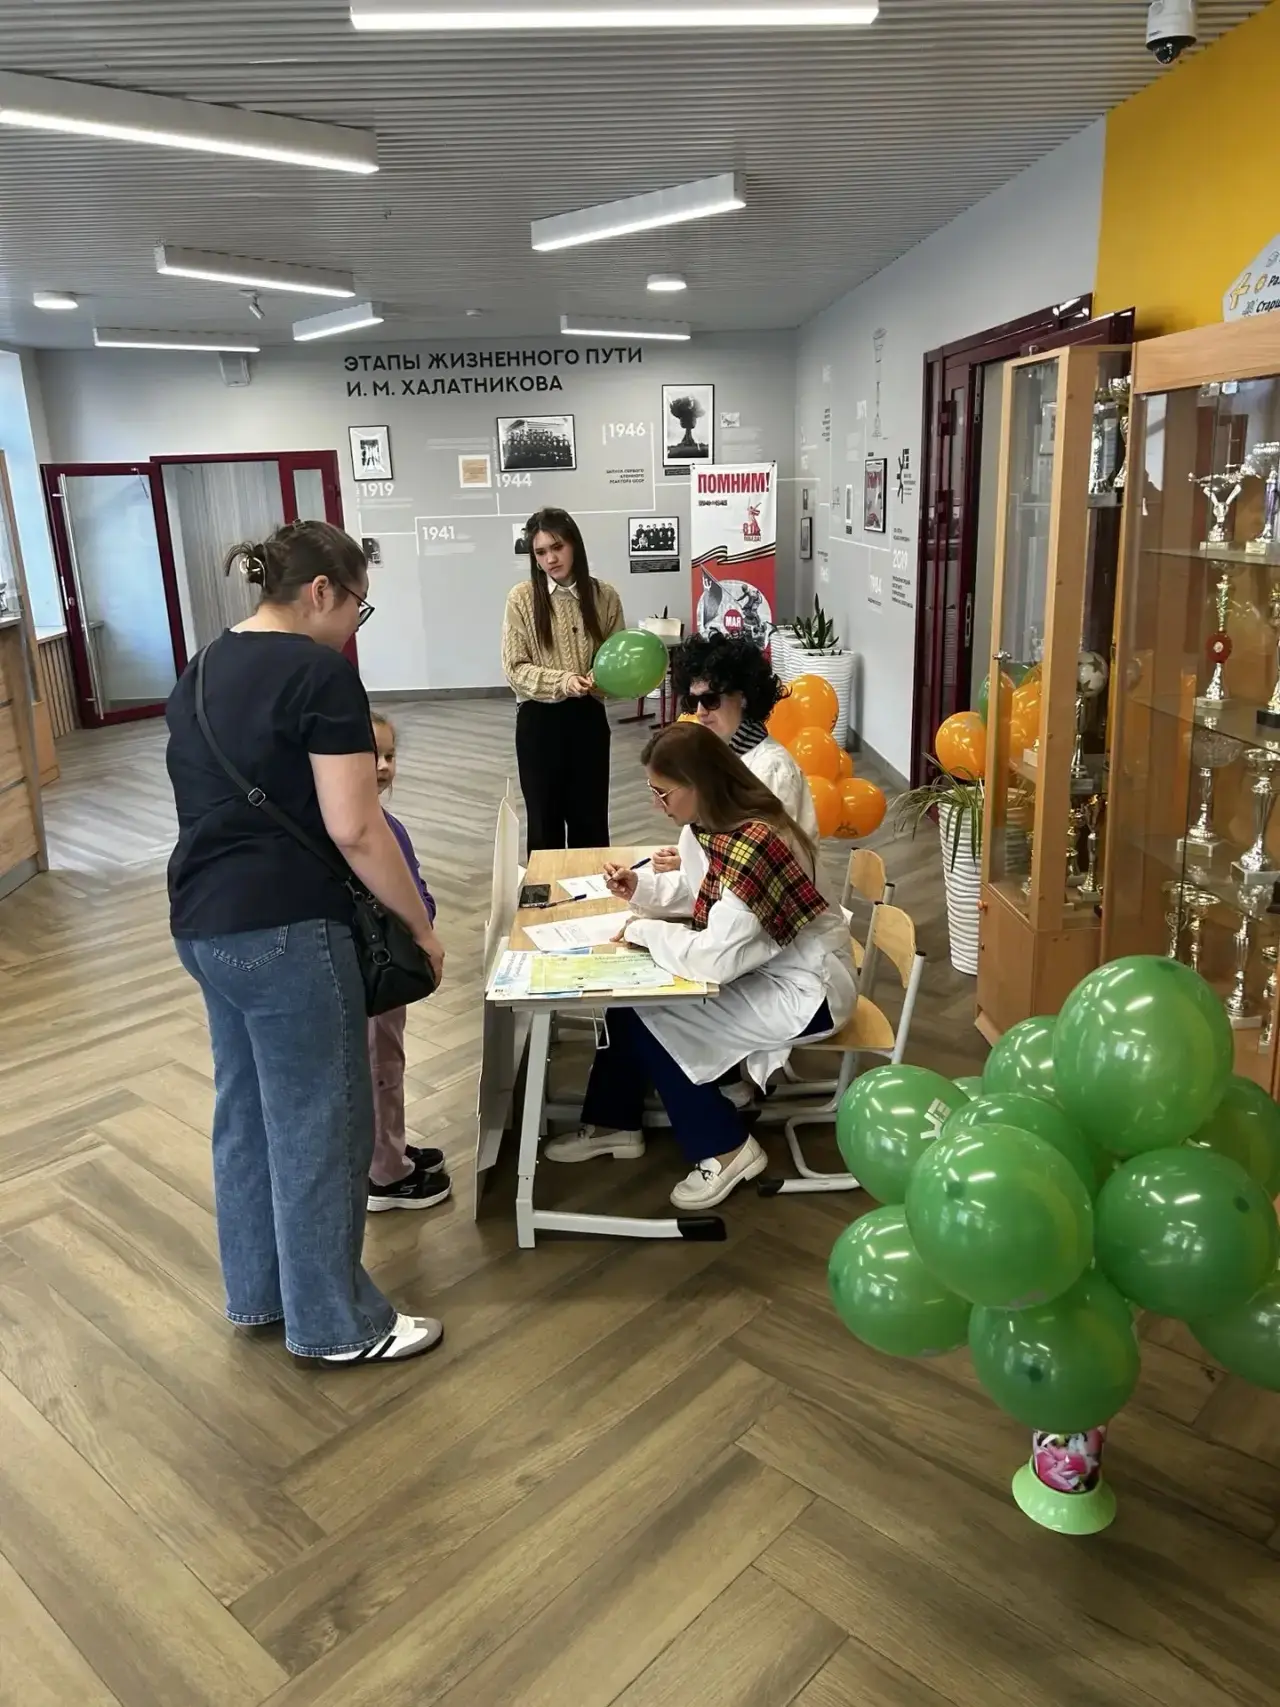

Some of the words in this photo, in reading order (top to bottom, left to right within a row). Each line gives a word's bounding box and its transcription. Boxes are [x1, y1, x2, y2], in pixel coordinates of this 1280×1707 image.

[344, 354, 421, 371] ЭТАПЫ
[428, 349, 580, 370] ЖИЗНЕННОГО
[586, 347, 643, 365] ПУТИ
[346, 381, 368, 397] И.
[373, 381, 396, 397] М.
[401, 375, 564, 396] ХАЛАТНИКОВА
[608, 422, 646, 438] 1946
[495, 473, 532, 488] 1944
[697, 472, 770, 493] ПОМНИМ!
[361, 482, 394, 497] 1919
[422, 526, 455, 540] 1941
[725, 616, 742, 627] МАЯ
